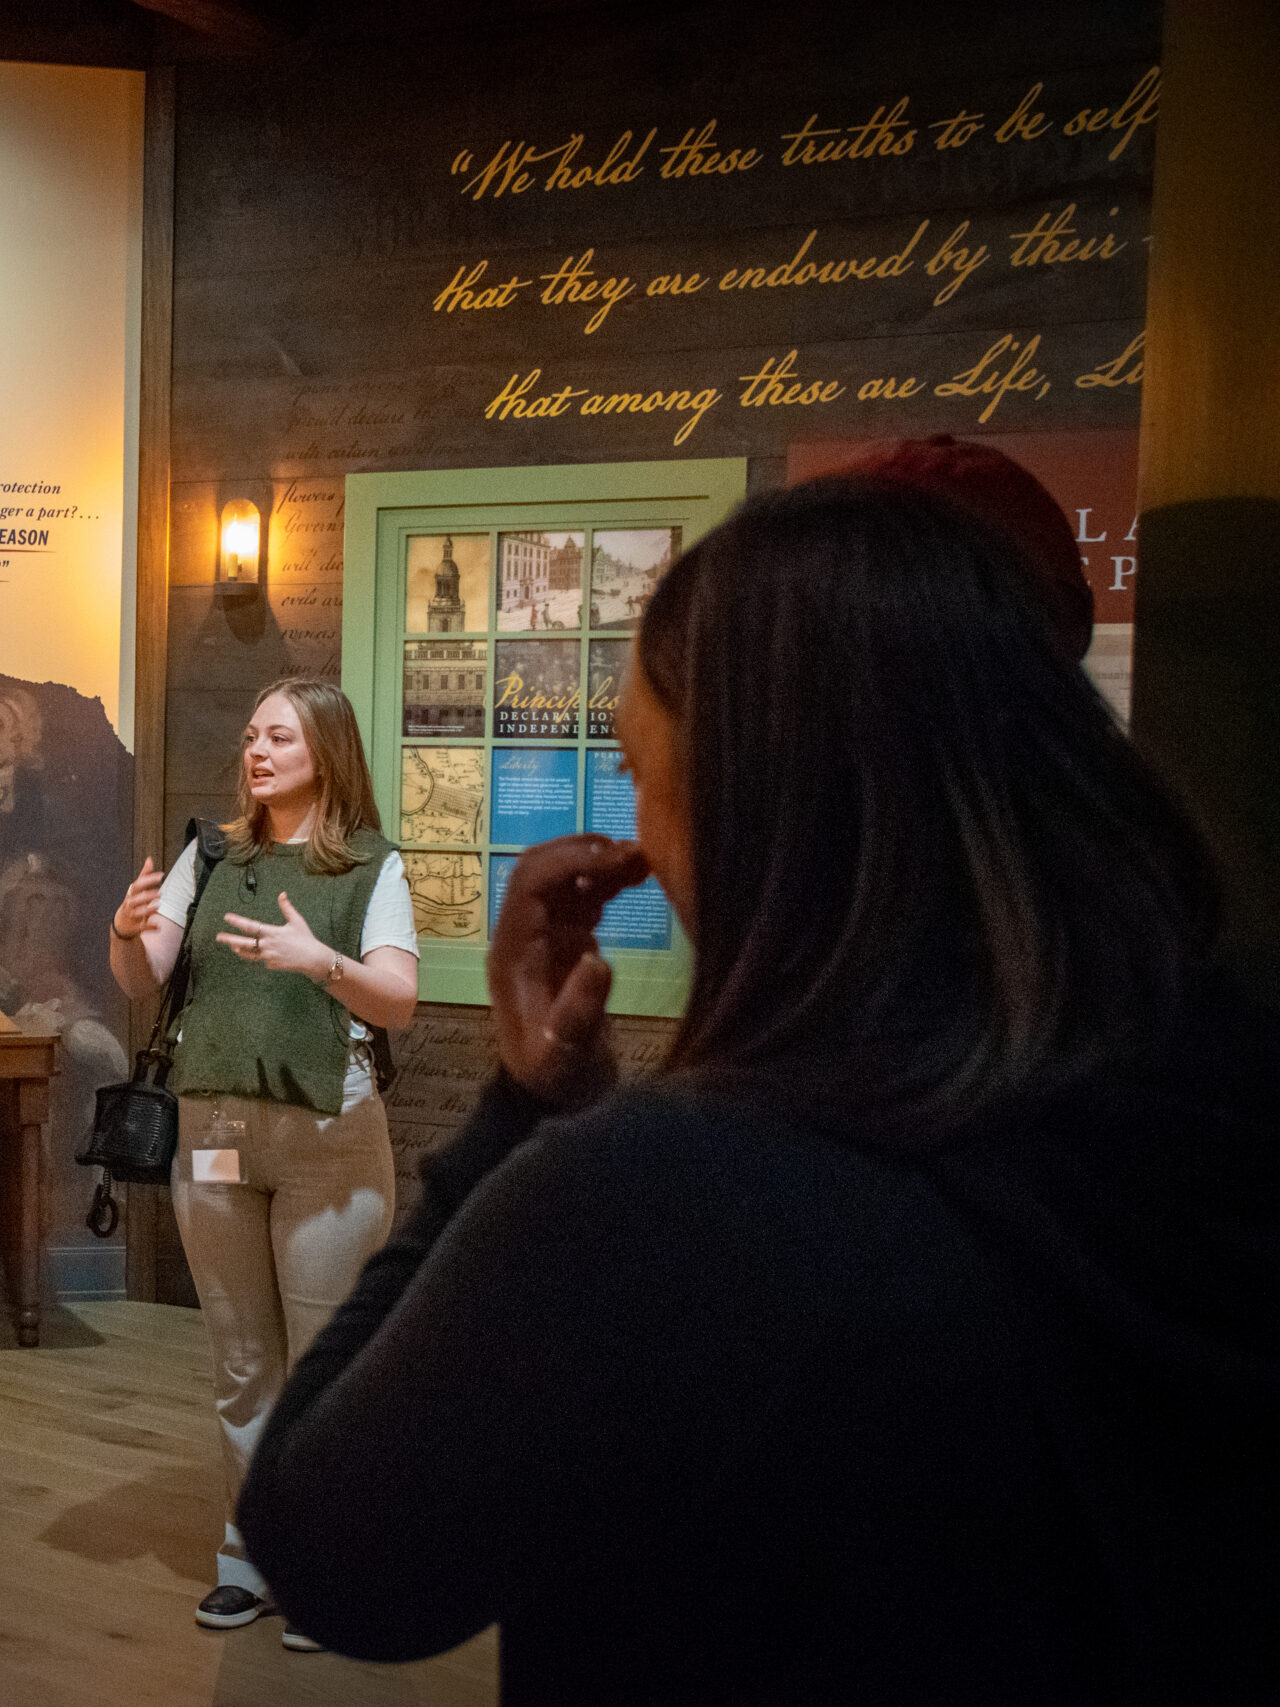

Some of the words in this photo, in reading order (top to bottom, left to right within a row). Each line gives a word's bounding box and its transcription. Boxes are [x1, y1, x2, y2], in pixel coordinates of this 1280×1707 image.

[544, 126, 658, 194] hold
[660, 119, 762, 178] these
[782, 96, 916, 166] truths
[928, 110, 984, 151] to
[995, 82, 1055, 144] be
[433, 260, 533, 312] that
[540, 248, 636, 335] they
[646, 273, 710, 296] are
[718, 219, 930, 290] endowed
[925, 221, 990, 306] by
[1008, 203, 1129, 267] their
[485, 369, 589, 420] that
[579, 389, 722, 446] among
[739, 349, 846, 407] these
[858, 377, 925, 400] are
[934, 334, 1050, 424] Life,
[26, 508, 34, 517] a
[495, 675, 619, 723] Principles
